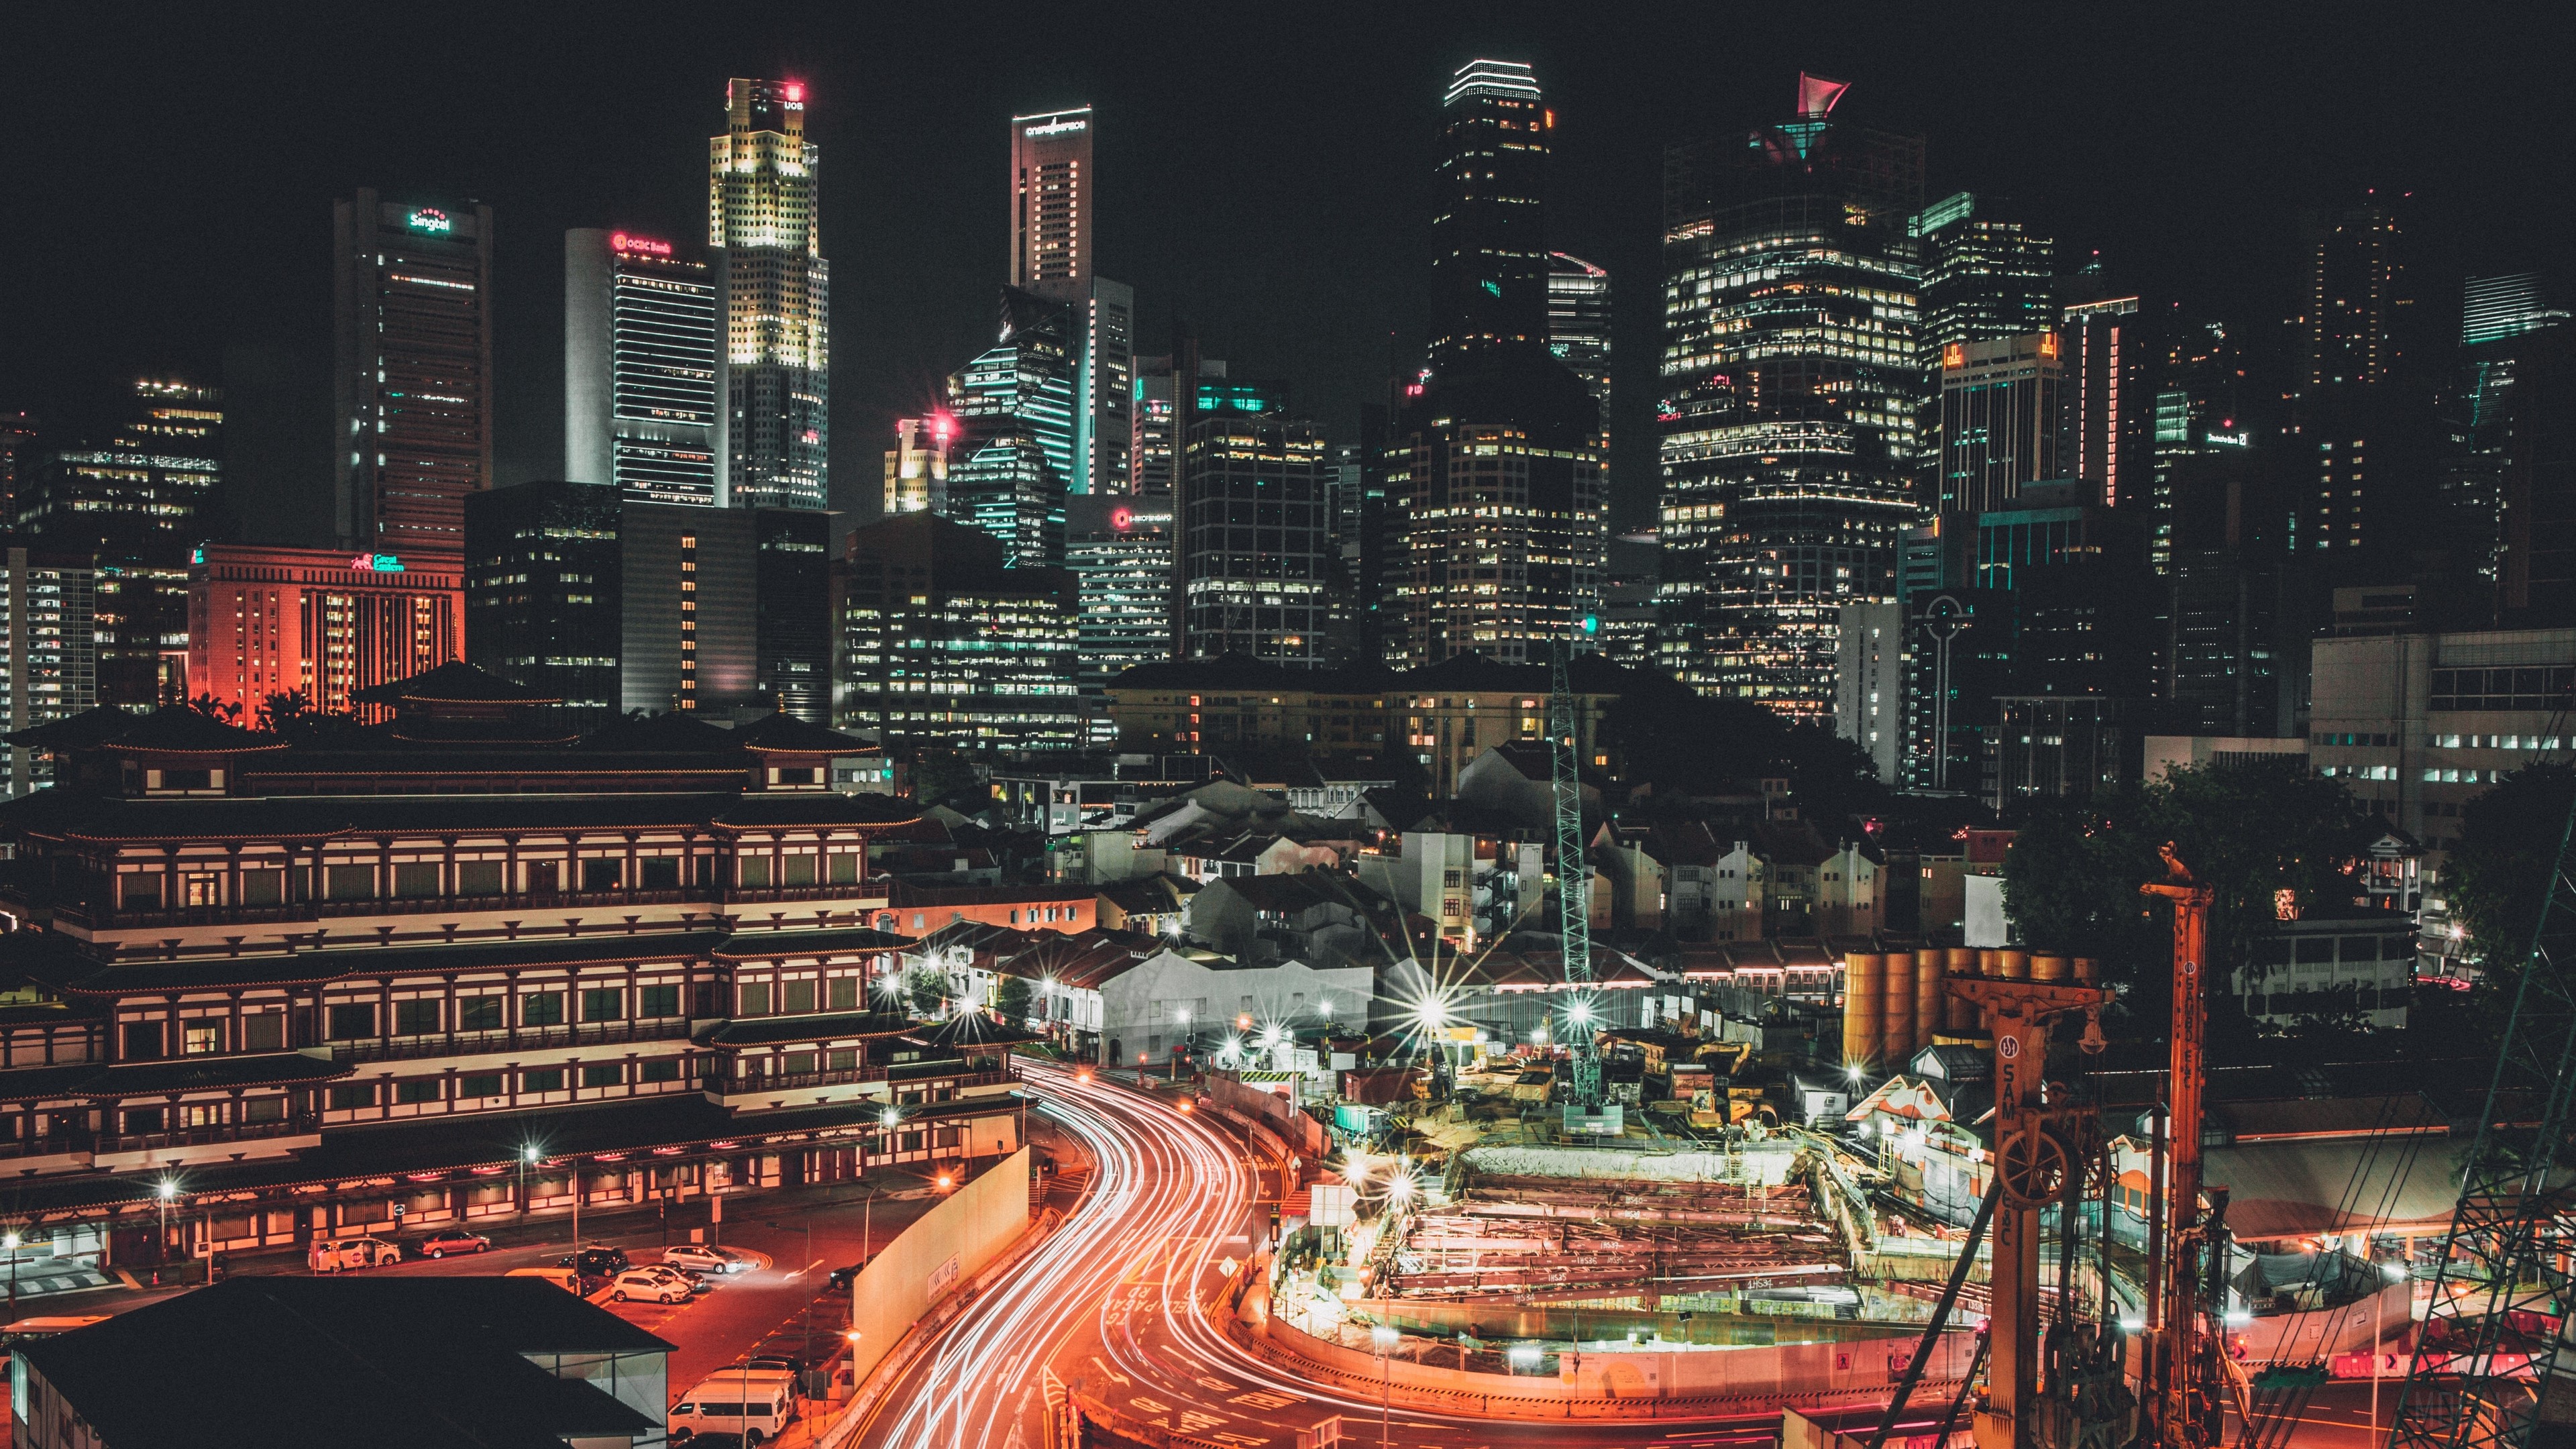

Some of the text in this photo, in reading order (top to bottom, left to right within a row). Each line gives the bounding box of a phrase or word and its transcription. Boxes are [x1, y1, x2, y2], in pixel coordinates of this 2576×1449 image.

[784, 101, 803, 110] UOB
[411, 215, 449, 231] Singtel
[627, 239, 670, 254] OCBC Bank
[374, 554, 397, 564] Great
[374, 563, 405, 572] Eastern
[1128, 1286, 1152, 1299] RD
[1130, 1397, 1173, 1413] RD
